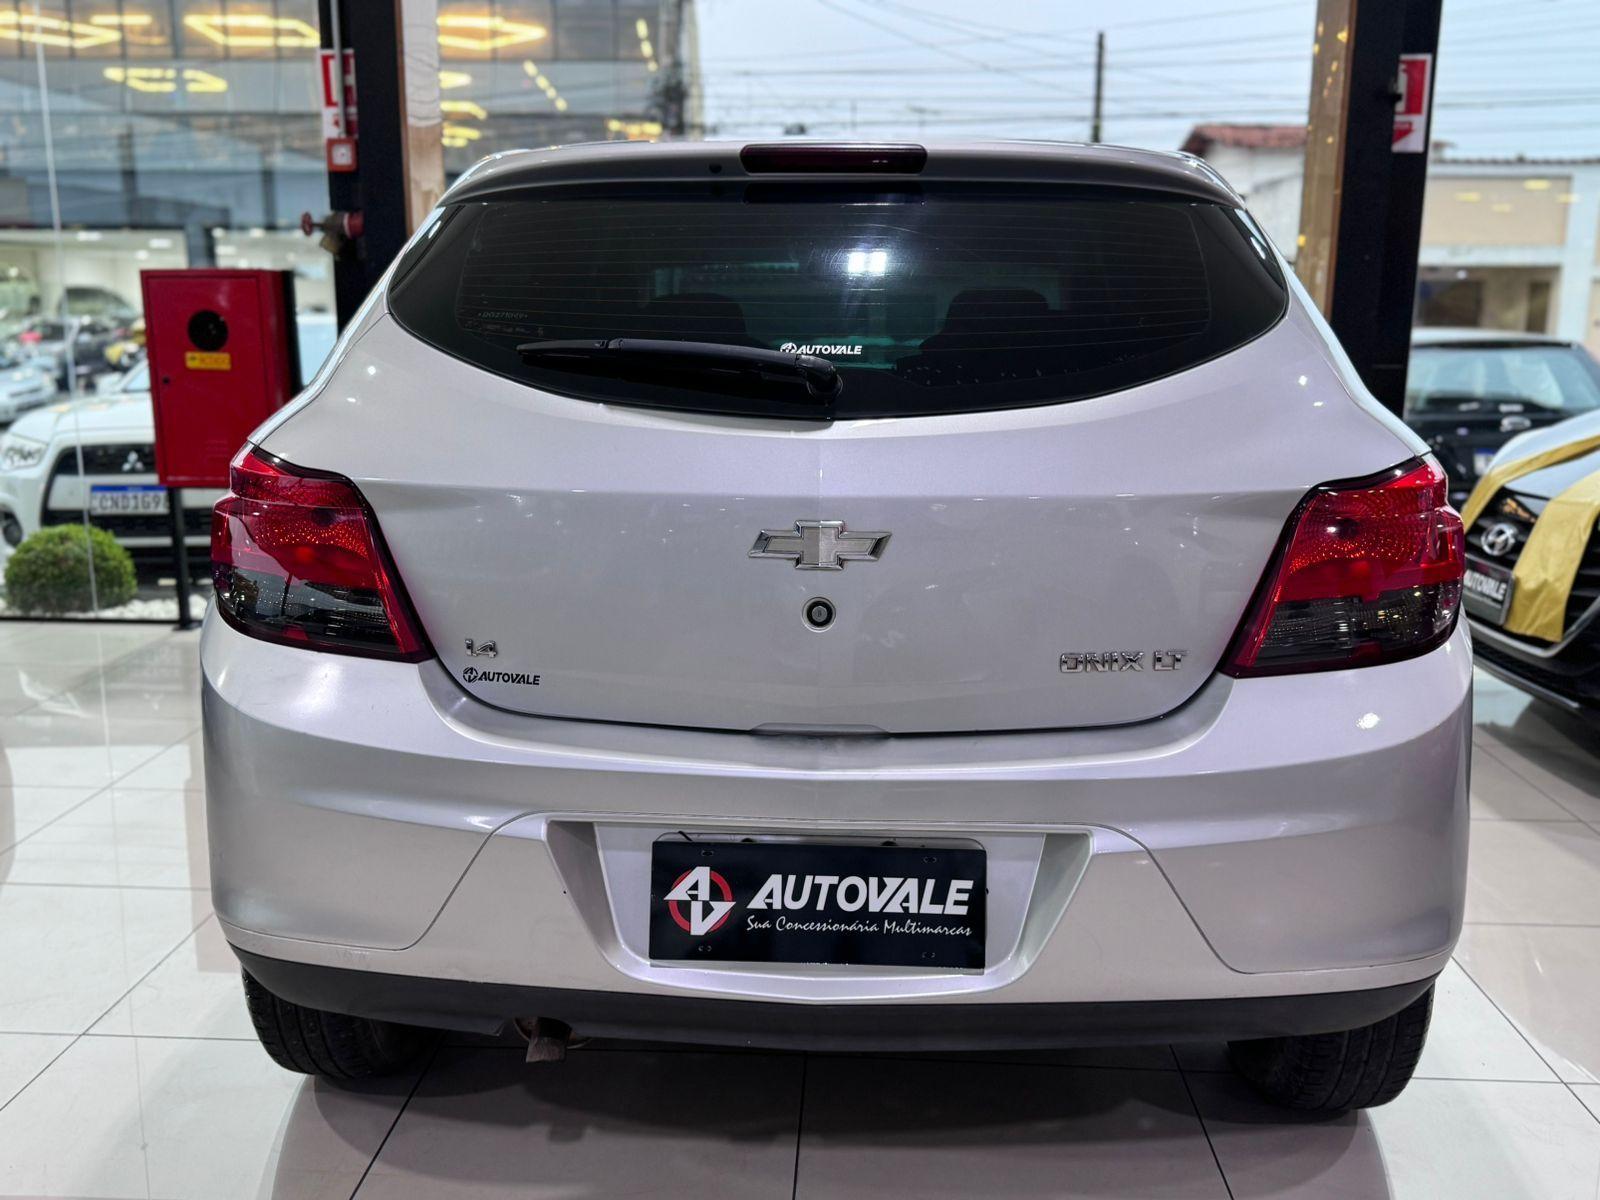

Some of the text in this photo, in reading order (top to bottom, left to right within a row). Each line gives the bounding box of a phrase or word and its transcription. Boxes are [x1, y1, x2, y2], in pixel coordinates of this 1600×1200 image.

[796, 344, 863, 355] AUTOVALE
[1060, 650, 1188, 674] ONIX LT
[478, 671, 541, 686] AUTOVALE
[746, 873, 975, 916] AUTOVALE
[746, 914, 973, 937] Sua Concessionária Multimarcas
